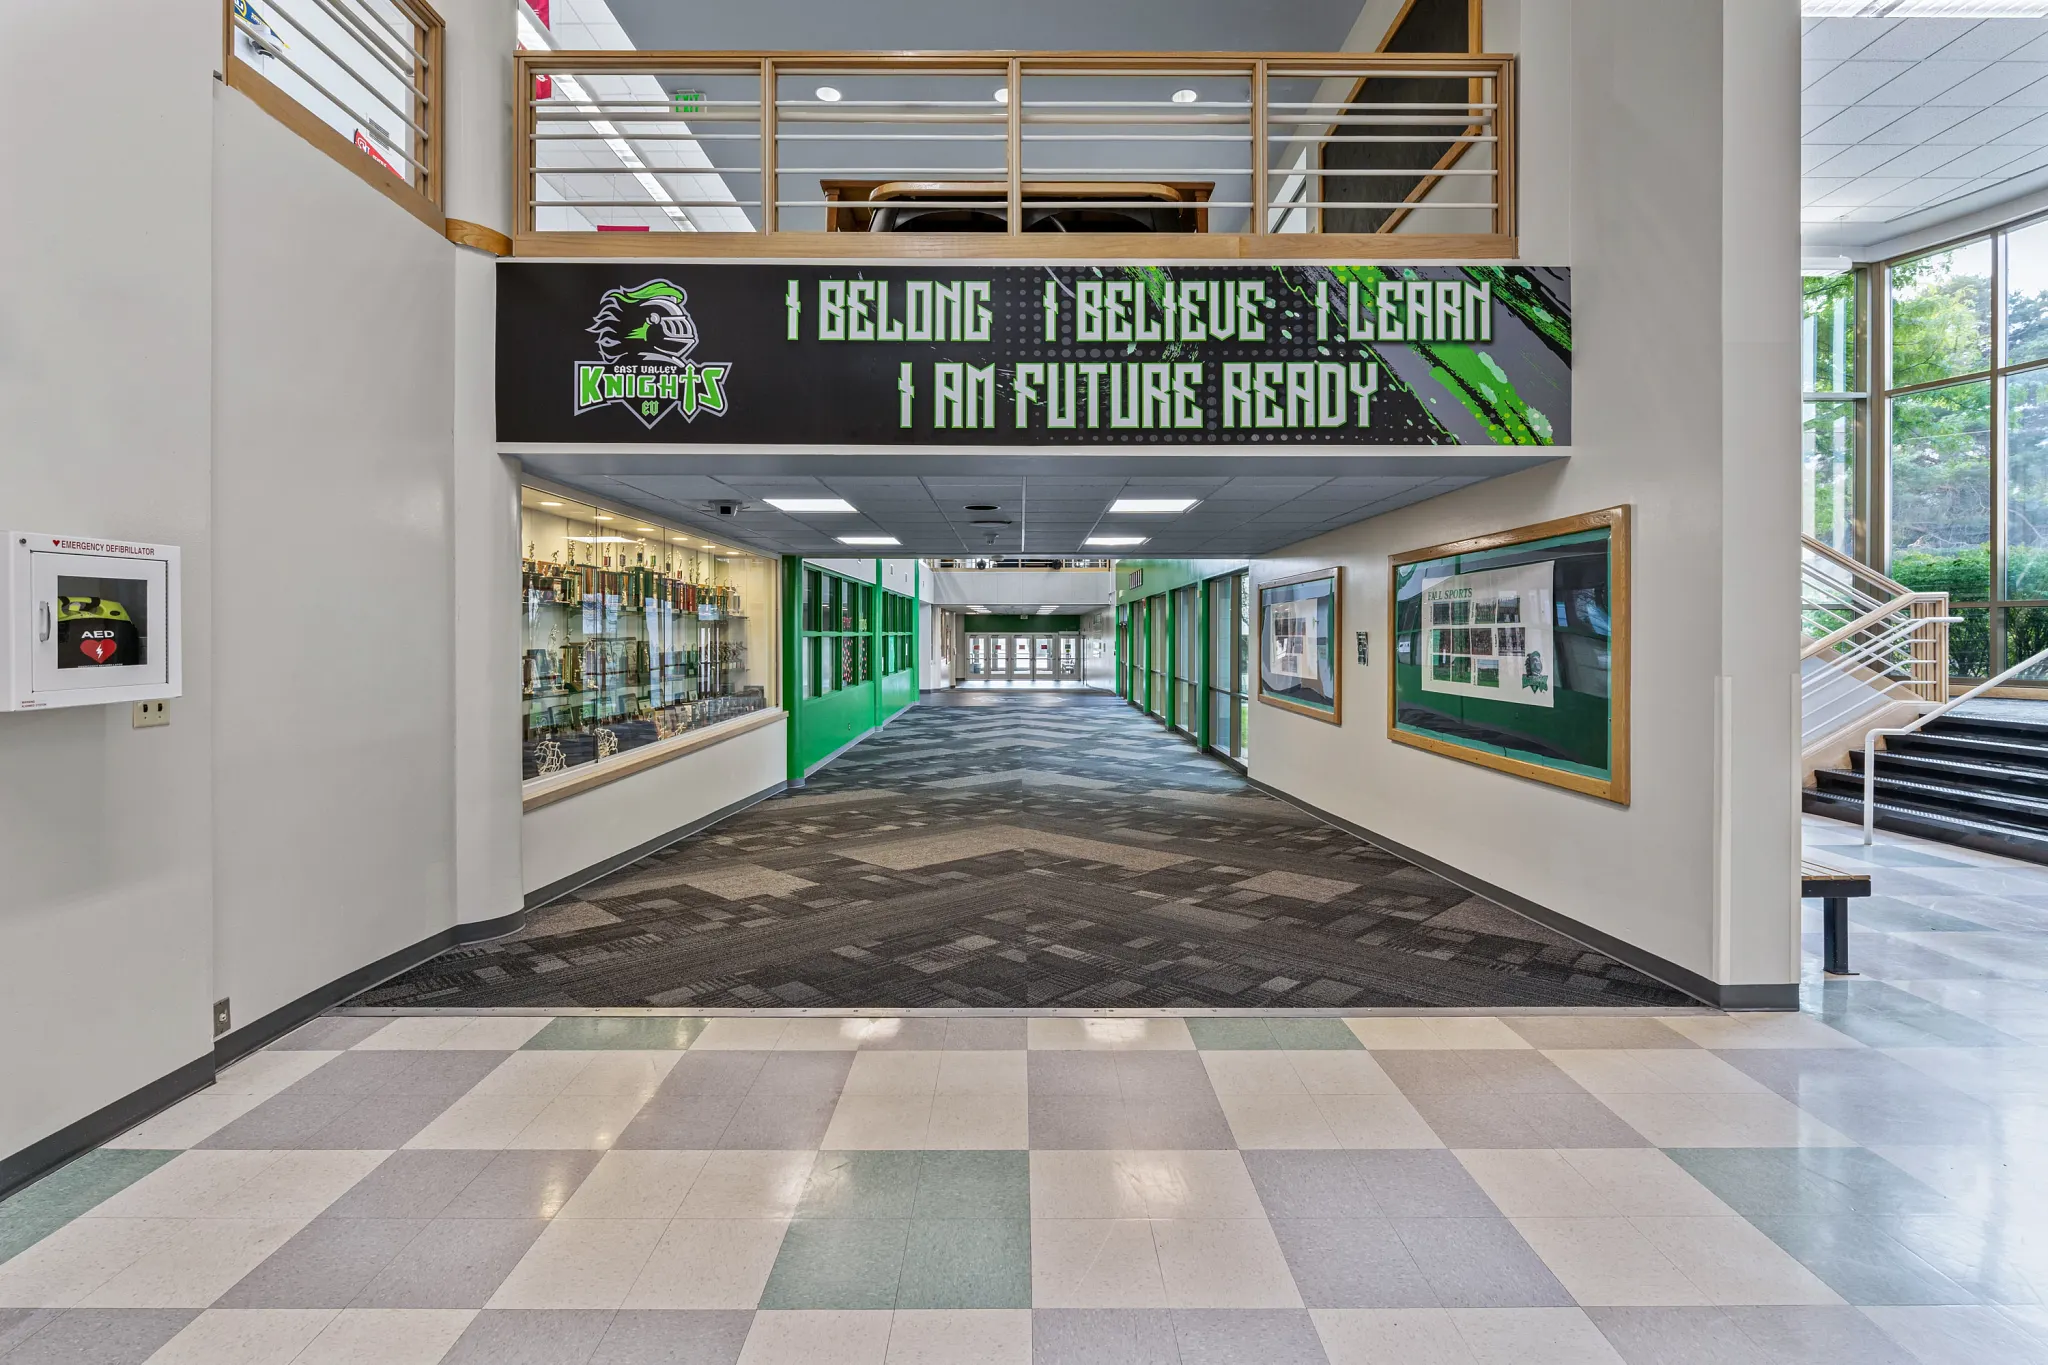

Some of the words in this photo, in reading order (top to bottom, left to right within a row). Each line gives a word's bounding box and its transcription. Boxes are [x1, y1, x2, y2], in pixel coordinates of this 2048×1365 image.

[675, 94, 700, 113] EXIT
[785, 280, 801, 341] I
[818, 280, 992, 342] BELONG
[1042, 280, 1058, 342] I
[1075, 280, 1266, 342] BELIEVE
[1314, 280, 1330, 342] I
[1347, 280, 1493, 342] LEARN
[614, 365, 638, 374] EAST
[641, 365, 678, 374] VALLEY
[897, 361, 915, 429] I
[933, 361, 996, 429] AM
[1013, 361, 1203, 429] FUTURE
[1222, 360, 1378, 429] READY
[61, 540, 105, 552] EMERGENCY
[105, 544, 155, 556] DEFIBRILLATOR
[1427, 590, 1443, 601] FALL
[1444, 587, 1473, 600] SPORTS
[81, 630, 115, 639] AED
